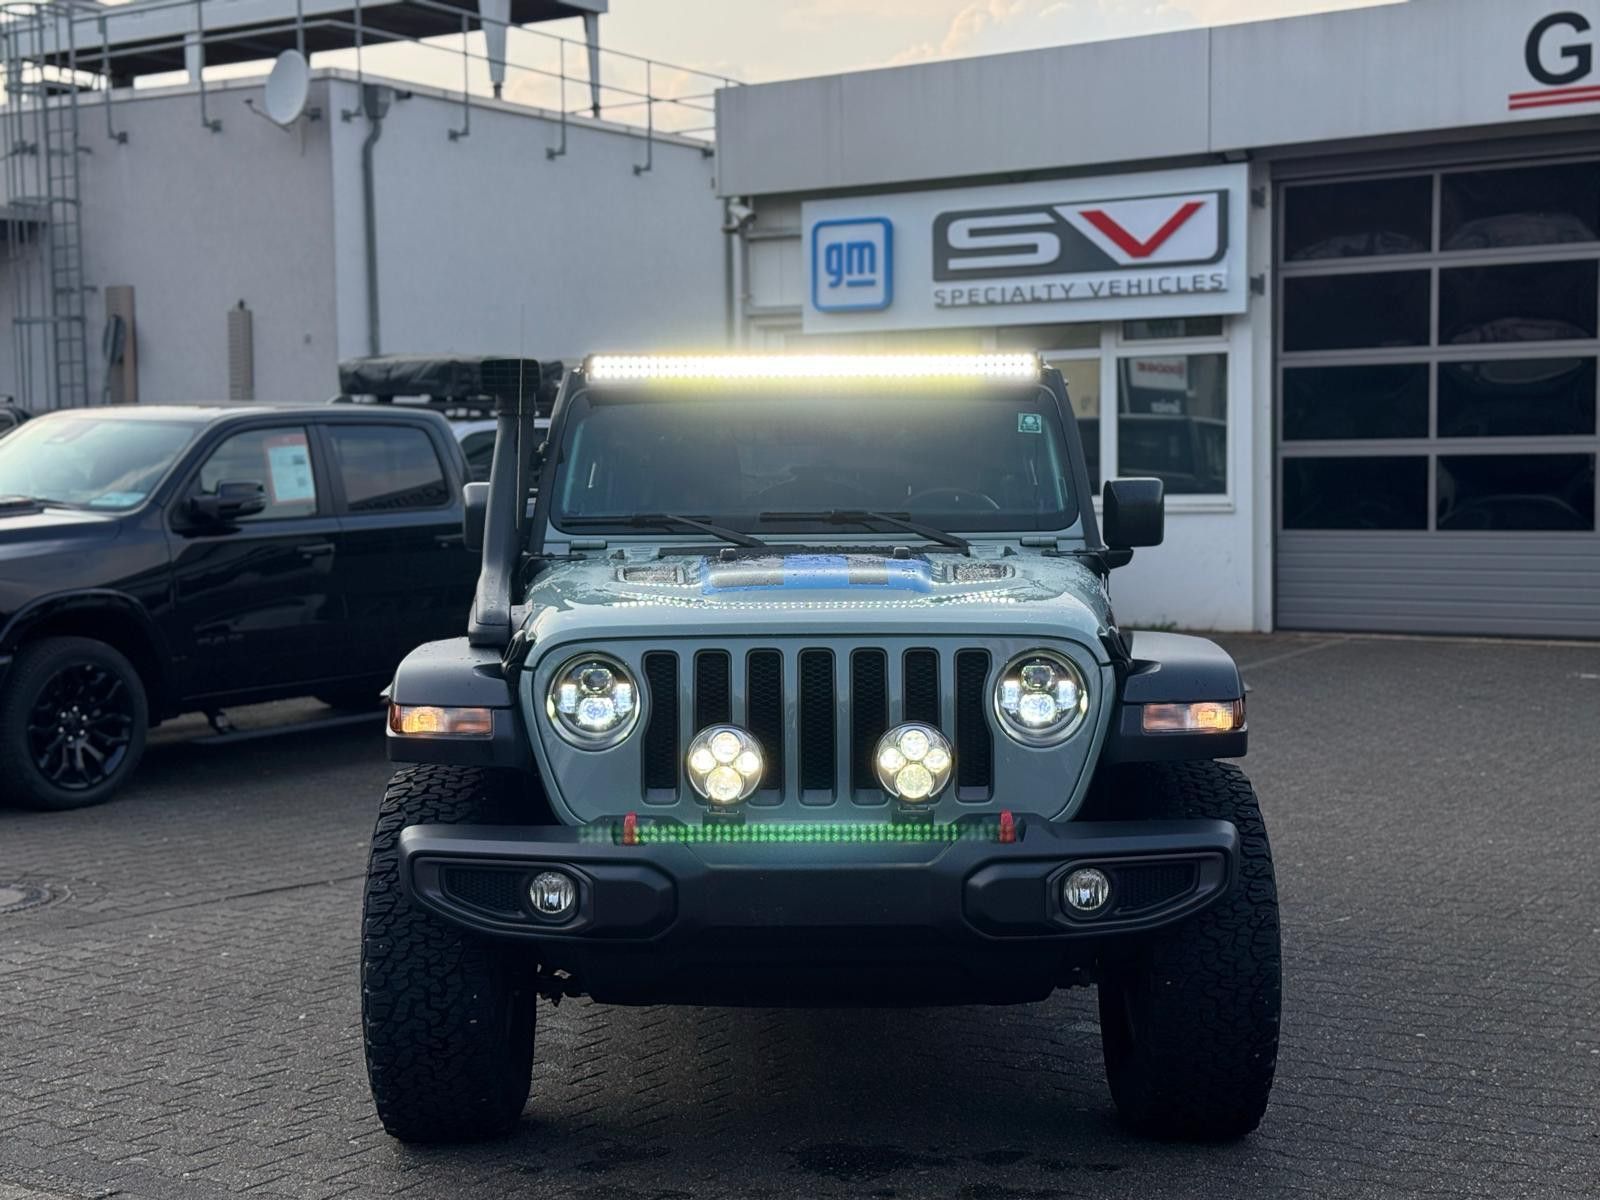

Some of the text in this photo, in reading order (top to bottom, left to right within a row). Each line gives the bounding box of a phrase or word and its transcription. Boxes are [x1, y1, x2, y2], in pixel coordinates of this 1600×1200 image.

[946, 199, 1208, 271] SV
[825, 240, 876, 289] gm
[933, 272, 1225, 305] SPECIALTY VEHICLES
